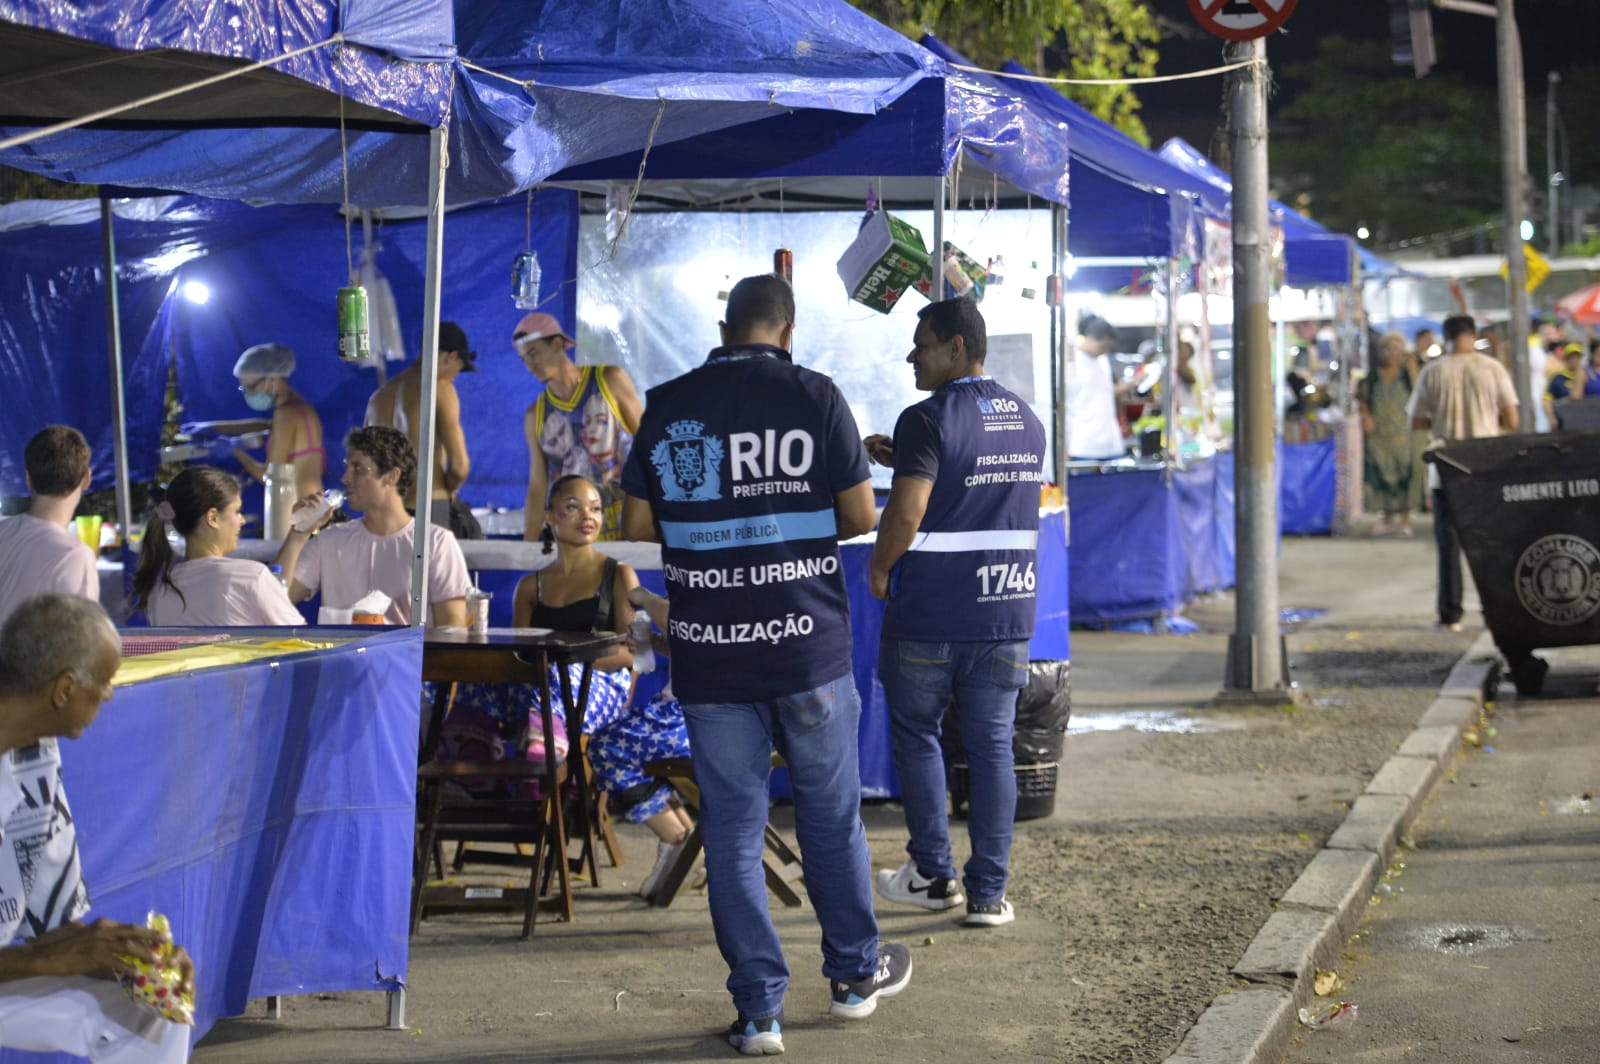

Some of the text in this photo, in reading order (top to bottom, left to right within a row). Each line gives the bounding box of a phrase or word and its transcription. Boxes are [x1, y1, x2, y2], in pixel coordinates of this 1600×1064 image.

[991, 398, 1019, 413] Rio
[729, 429, 814, 481] RIO
[977, 452, 1038, 467] FISCALIZAÇÃO
[964, 471, 1018, 487] CONTROLE
[733, 481, 811, 498] PREFEITURA
[1502, 479, 1599, 502] SOMENTE LIXO
[689, 528, 732, 544] ORDEM
[664, 555, 838, 588] ONTROLE URBANO
[976, 561, 1036, 595] 1746
[669, 613, 814, 645] FISCALIZAÇÃO
